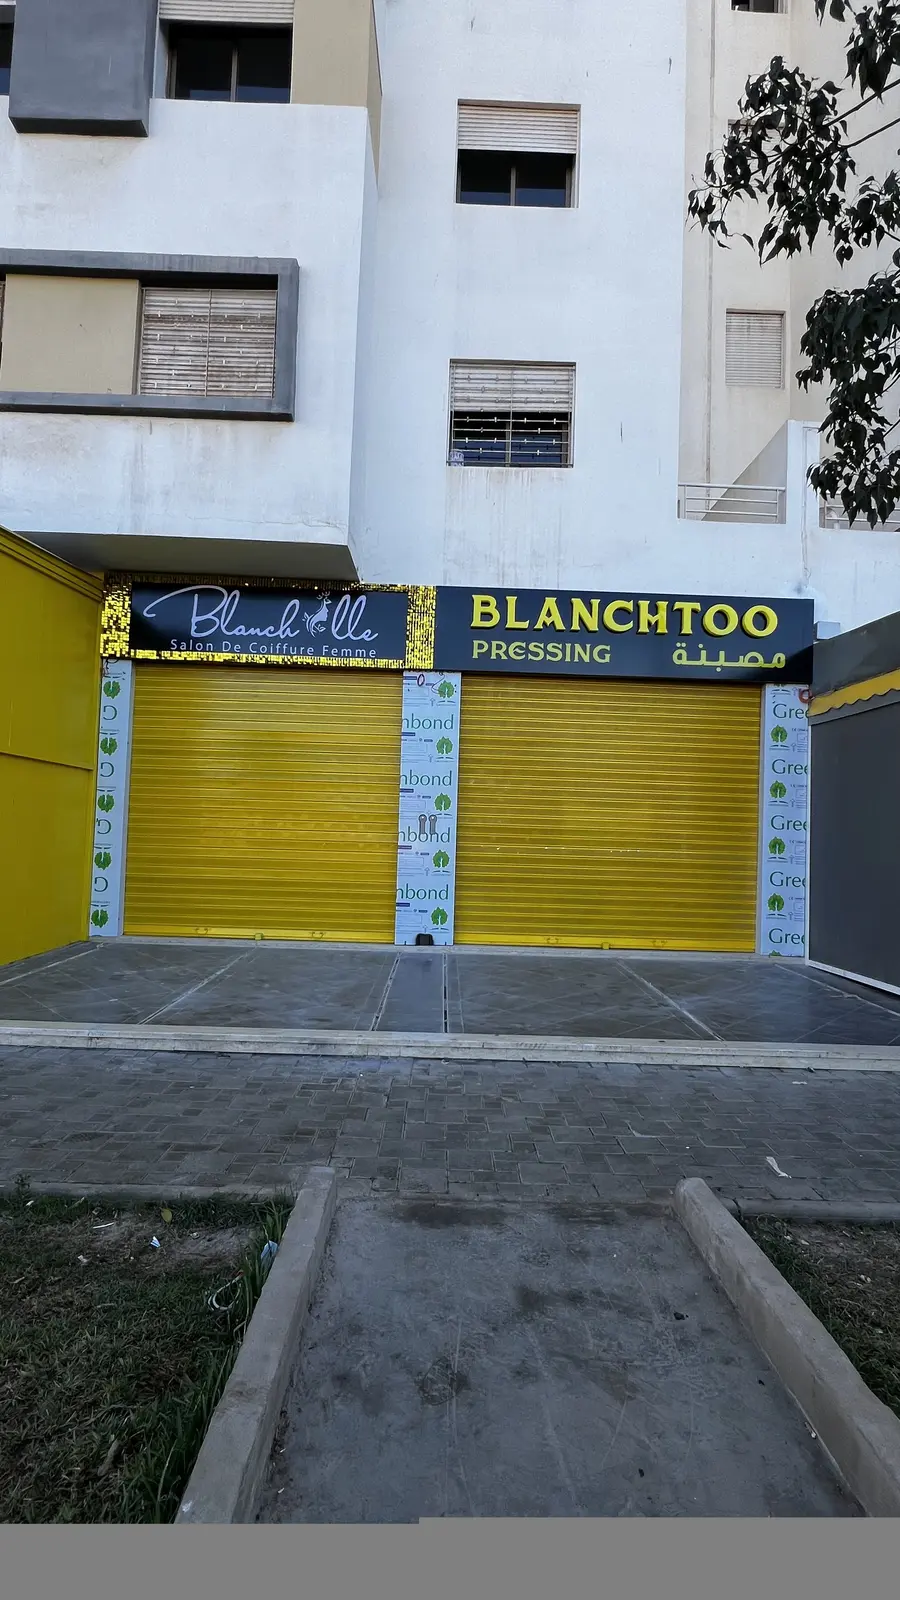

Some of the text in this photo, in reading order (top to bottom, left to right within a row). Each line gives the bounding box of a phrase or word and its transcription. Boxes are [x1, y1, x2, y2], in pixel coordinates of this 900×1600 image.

[470, 594, 779, 639] BLANCHTOO
[170, 638, 377, 659] Salon De Coiffure Femme
[472, 640, 611, 664] PRESSING
[672, 642, 786, 672] مصبنة
